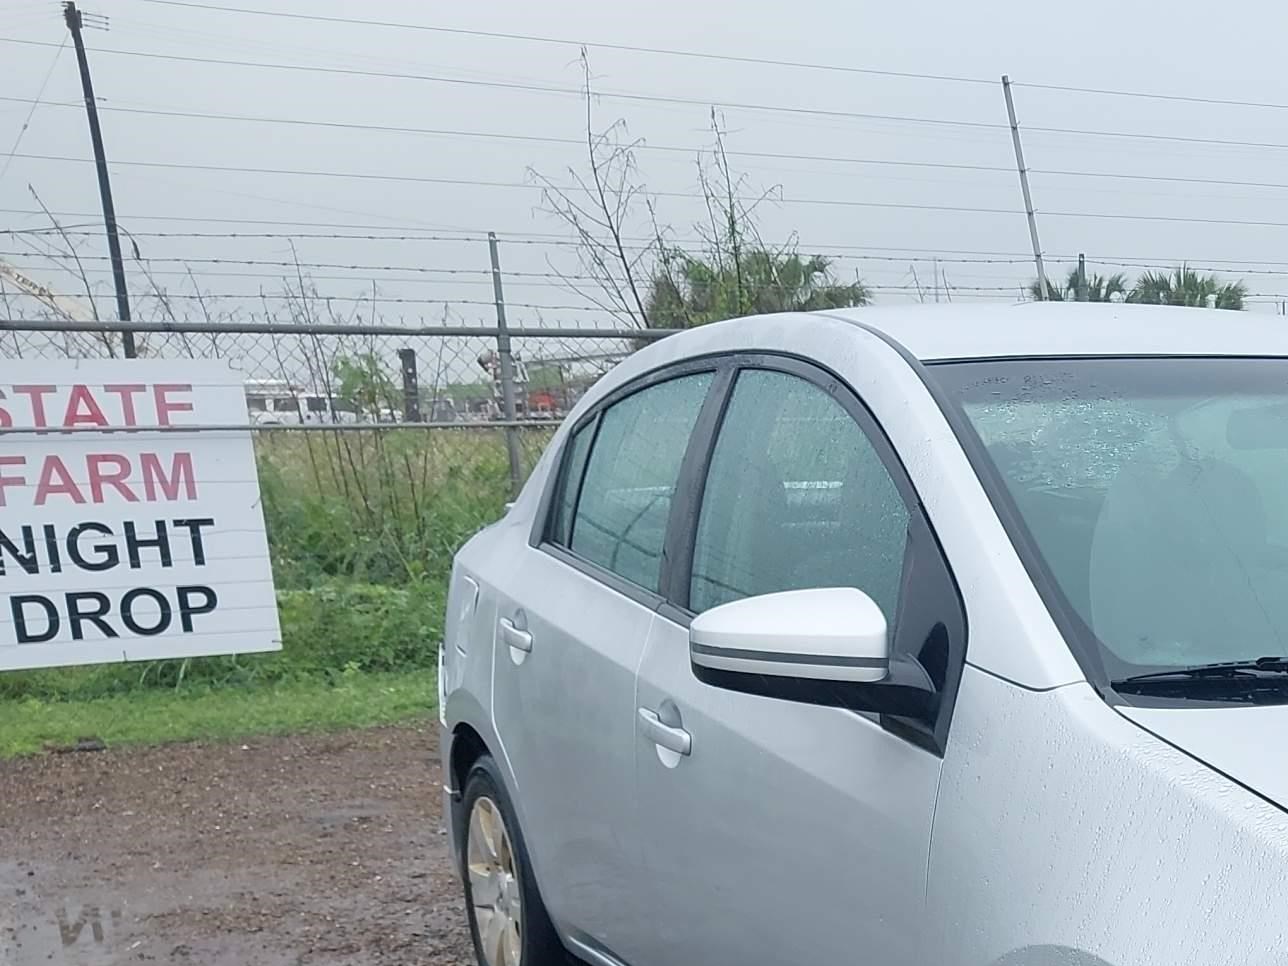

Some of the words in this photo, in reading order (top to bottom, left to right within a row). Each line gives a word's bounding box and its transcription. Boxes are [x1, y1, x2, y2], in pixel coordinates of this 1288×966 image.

[0, 452, 198, 507] FARM
[0, 518, 215, 576] NIGHT
[10, 586, 218, 644] DROP
